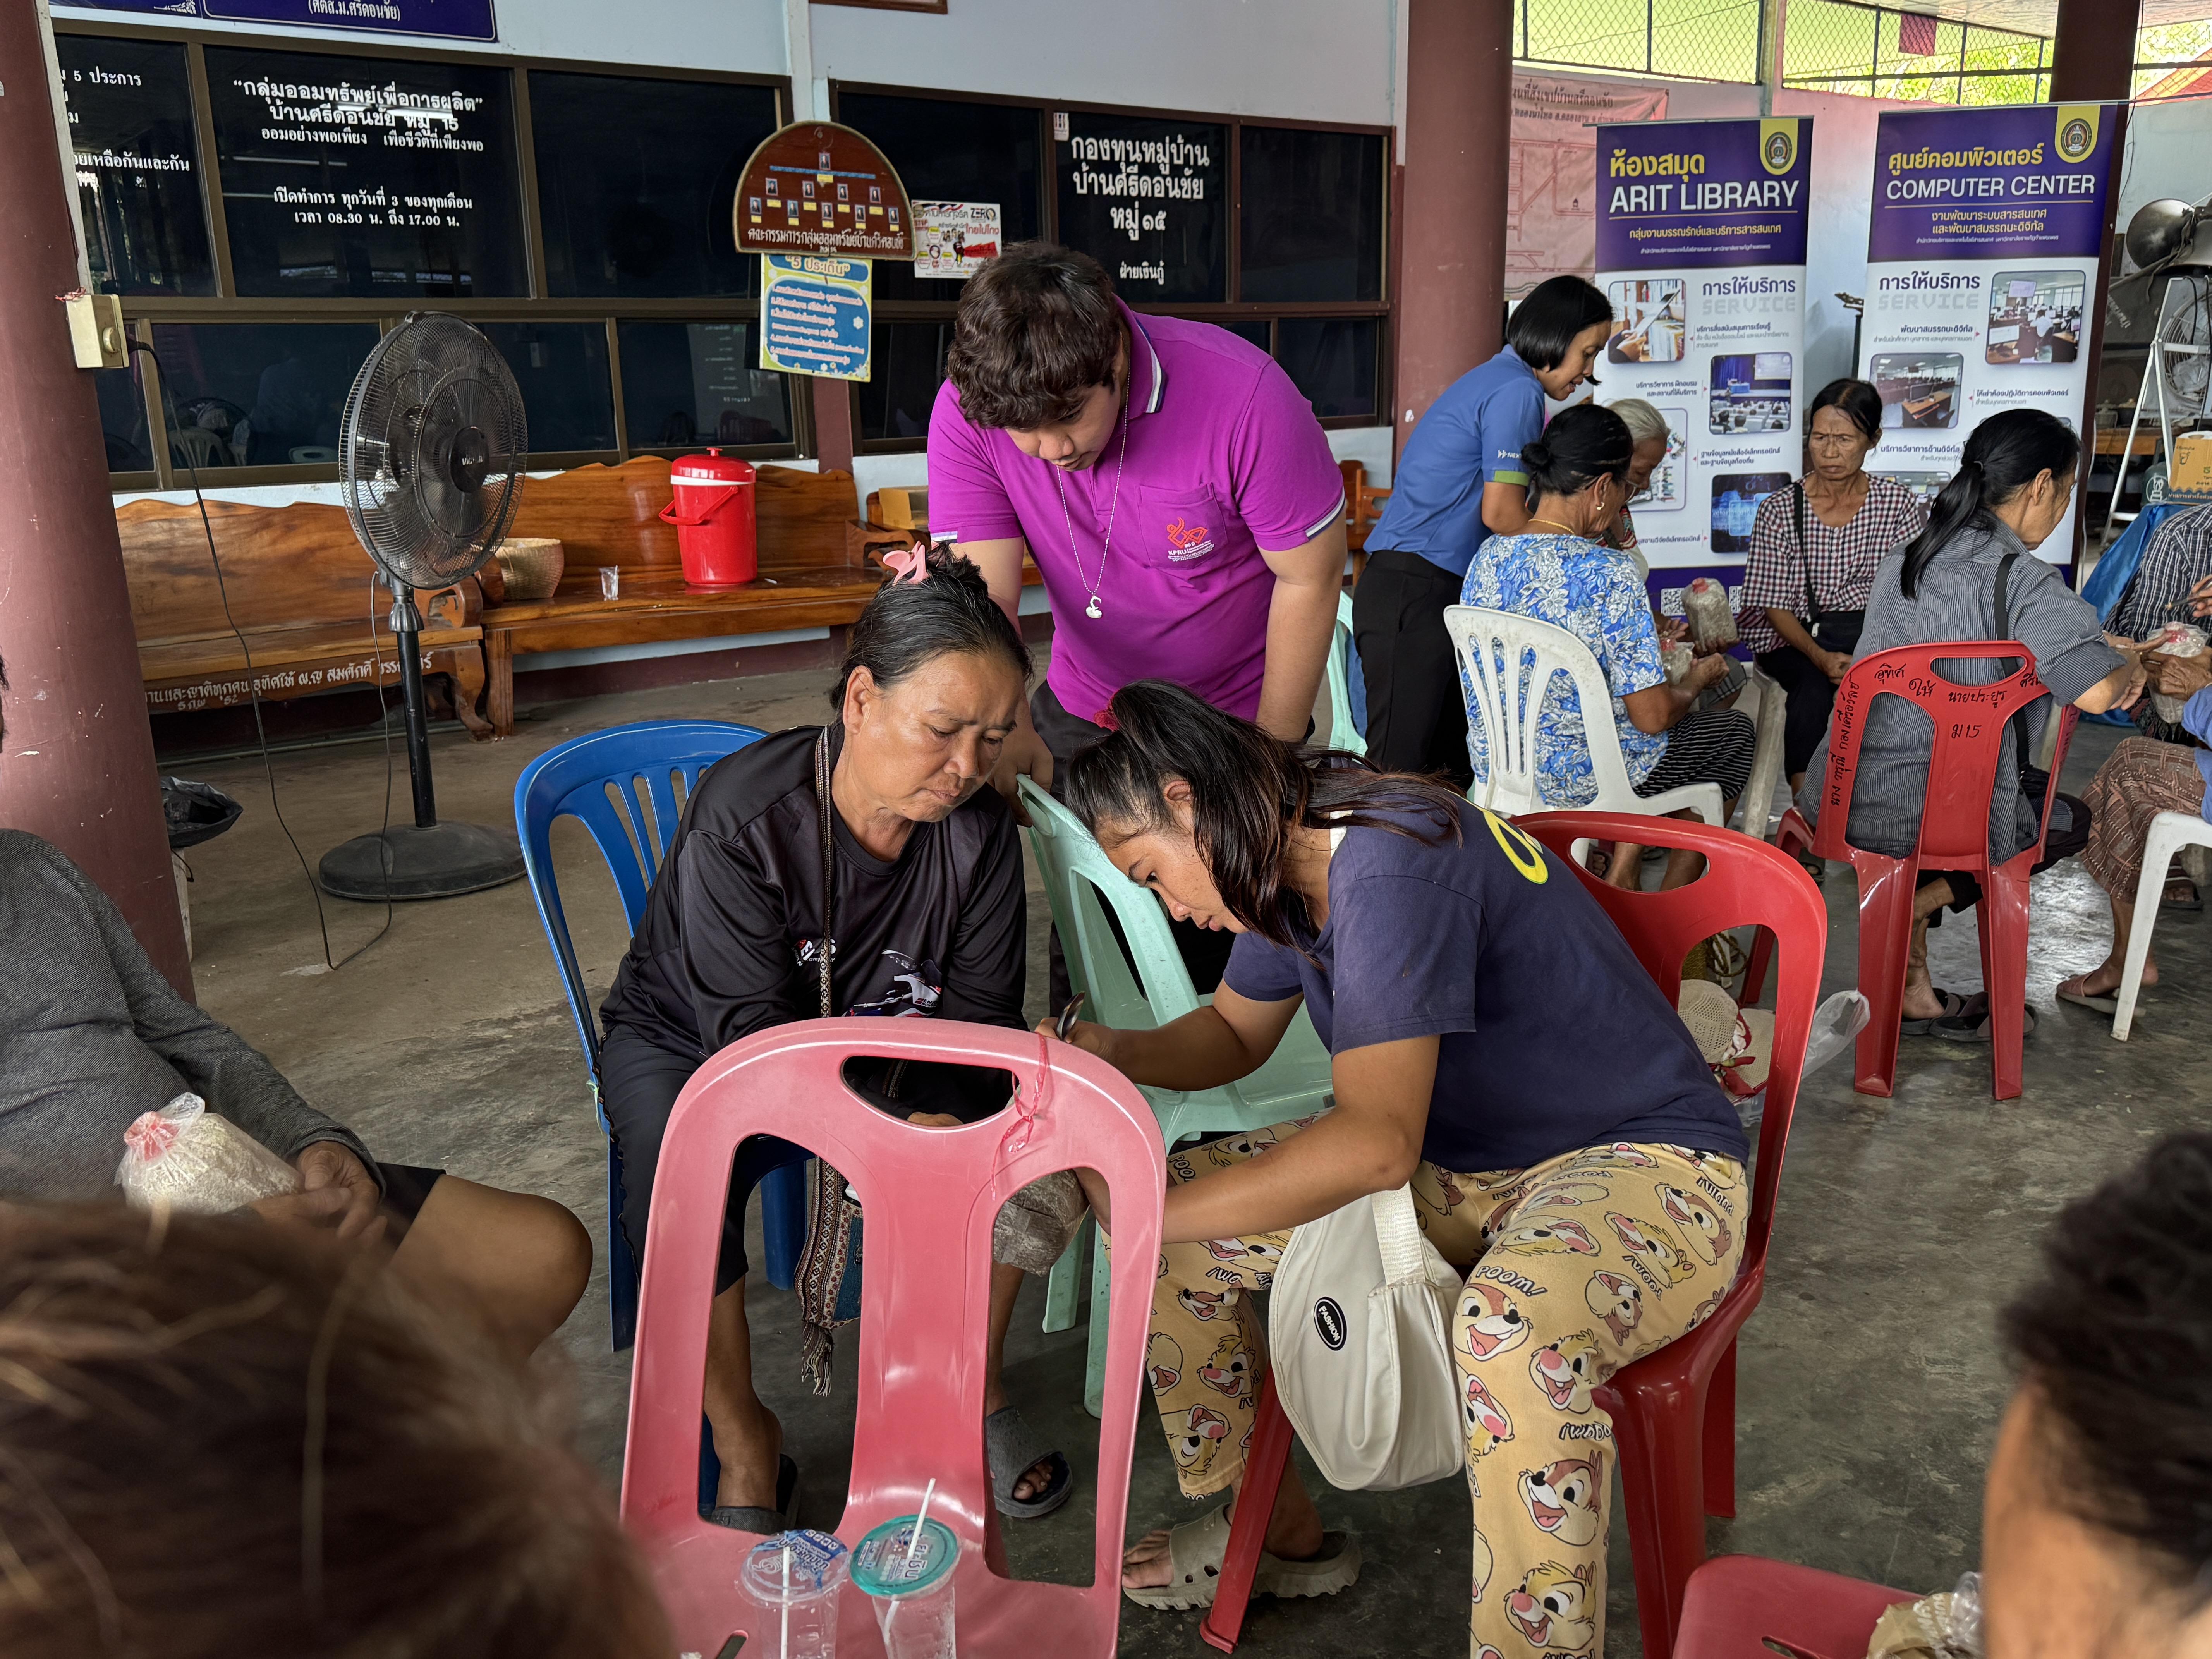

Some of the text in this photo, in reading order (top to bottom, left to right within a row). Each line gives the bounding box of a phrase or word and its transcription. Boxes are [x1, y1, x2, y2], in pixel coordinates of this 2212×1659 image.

[74, 70, 82, 82] 5
[89, 65, 142, 86] ประการ
[269, 99, 395, 127] บ้านศรีดอนชัย
[442, 118, 459, 131] 15
[261, 125, 367, 145] ออมอย่างพอเพียง
[1071, 134, 1210, 175] กองทุนหมู่บ้าน
[1610, 149, 1705, 182] ห้องสมุด
[1888, 142, 2044, 175] ศูนย์คอมพิวเตอร์
[1073, 162, 1204, 199] บ้านศรีดอนชัย
[1886, 174, 2095, 200] COMPUTER CENTER
[274, 186, 473, 213] เปิดทำการ ทุกวันที่ 3 ของทุกเดือน
[1609, 180, 1799, 213] ARIT LIBRARY
[295, 208, 460, 227] เวลา 08.30 น. ถึง 17.00 น.
[1110, 200, 1167, 241] หมู่ ๑๕
[1932, 208, 2047, 222] งานพัฒนาระบบสารสนเทศ
[1932, 220, 2044, 235] และพัฒนาสมรรถนะดิจิทัล
[1629, 224, 1781, 242] กลุ่มงานบรรณรักษ์และบริการสารสนเทศ
[1120, 260, 1164, 285] ฝ่ายเงินกู้
[1879, 270, 1980, 291] การให้บริการ
[1702, 276, 1796, 296] การให้บริการ
[1702, 296, 1796, 316] SERVICE
[1877, 292, 1979, 311] SERVICE
[1476, 1265, 1549, 1297] POOM!
[1318, 1305, 1340, 1342] FASHION
